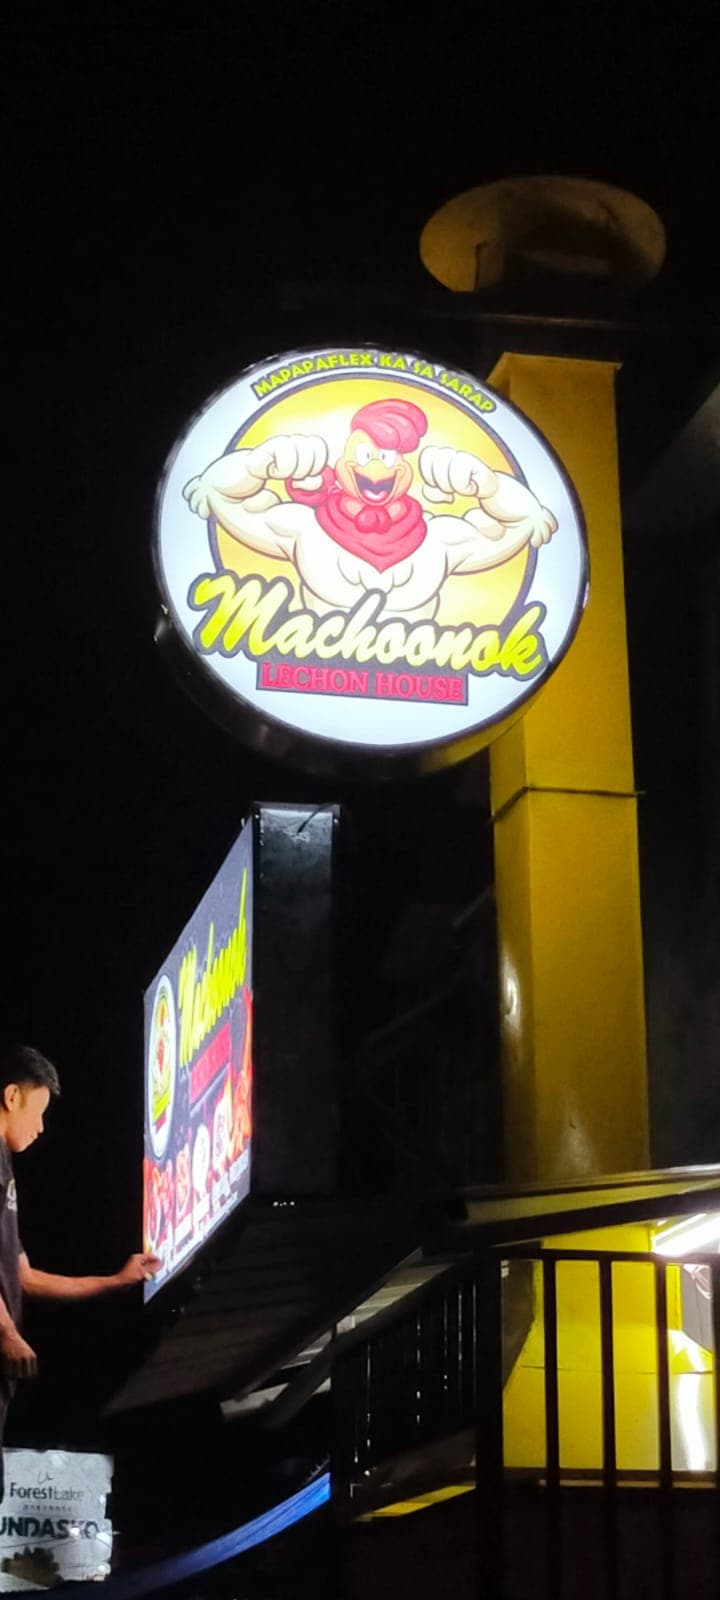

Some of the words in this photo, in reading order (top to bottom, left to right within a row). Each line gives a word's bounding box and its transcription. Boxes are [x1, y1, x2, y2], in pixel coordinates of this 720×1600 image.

[254, 352, 373, 397] MAPAPAFLEX
[379, 353, 407, 371] KA
[412, 360, 434, 380] SA
[440, 371, 495, 412] SARAP
[192, 574, 543, 676] Machoonok
[261, 661, 369, 695] LECHON
[375, 670, 465, 701] HOUSE
